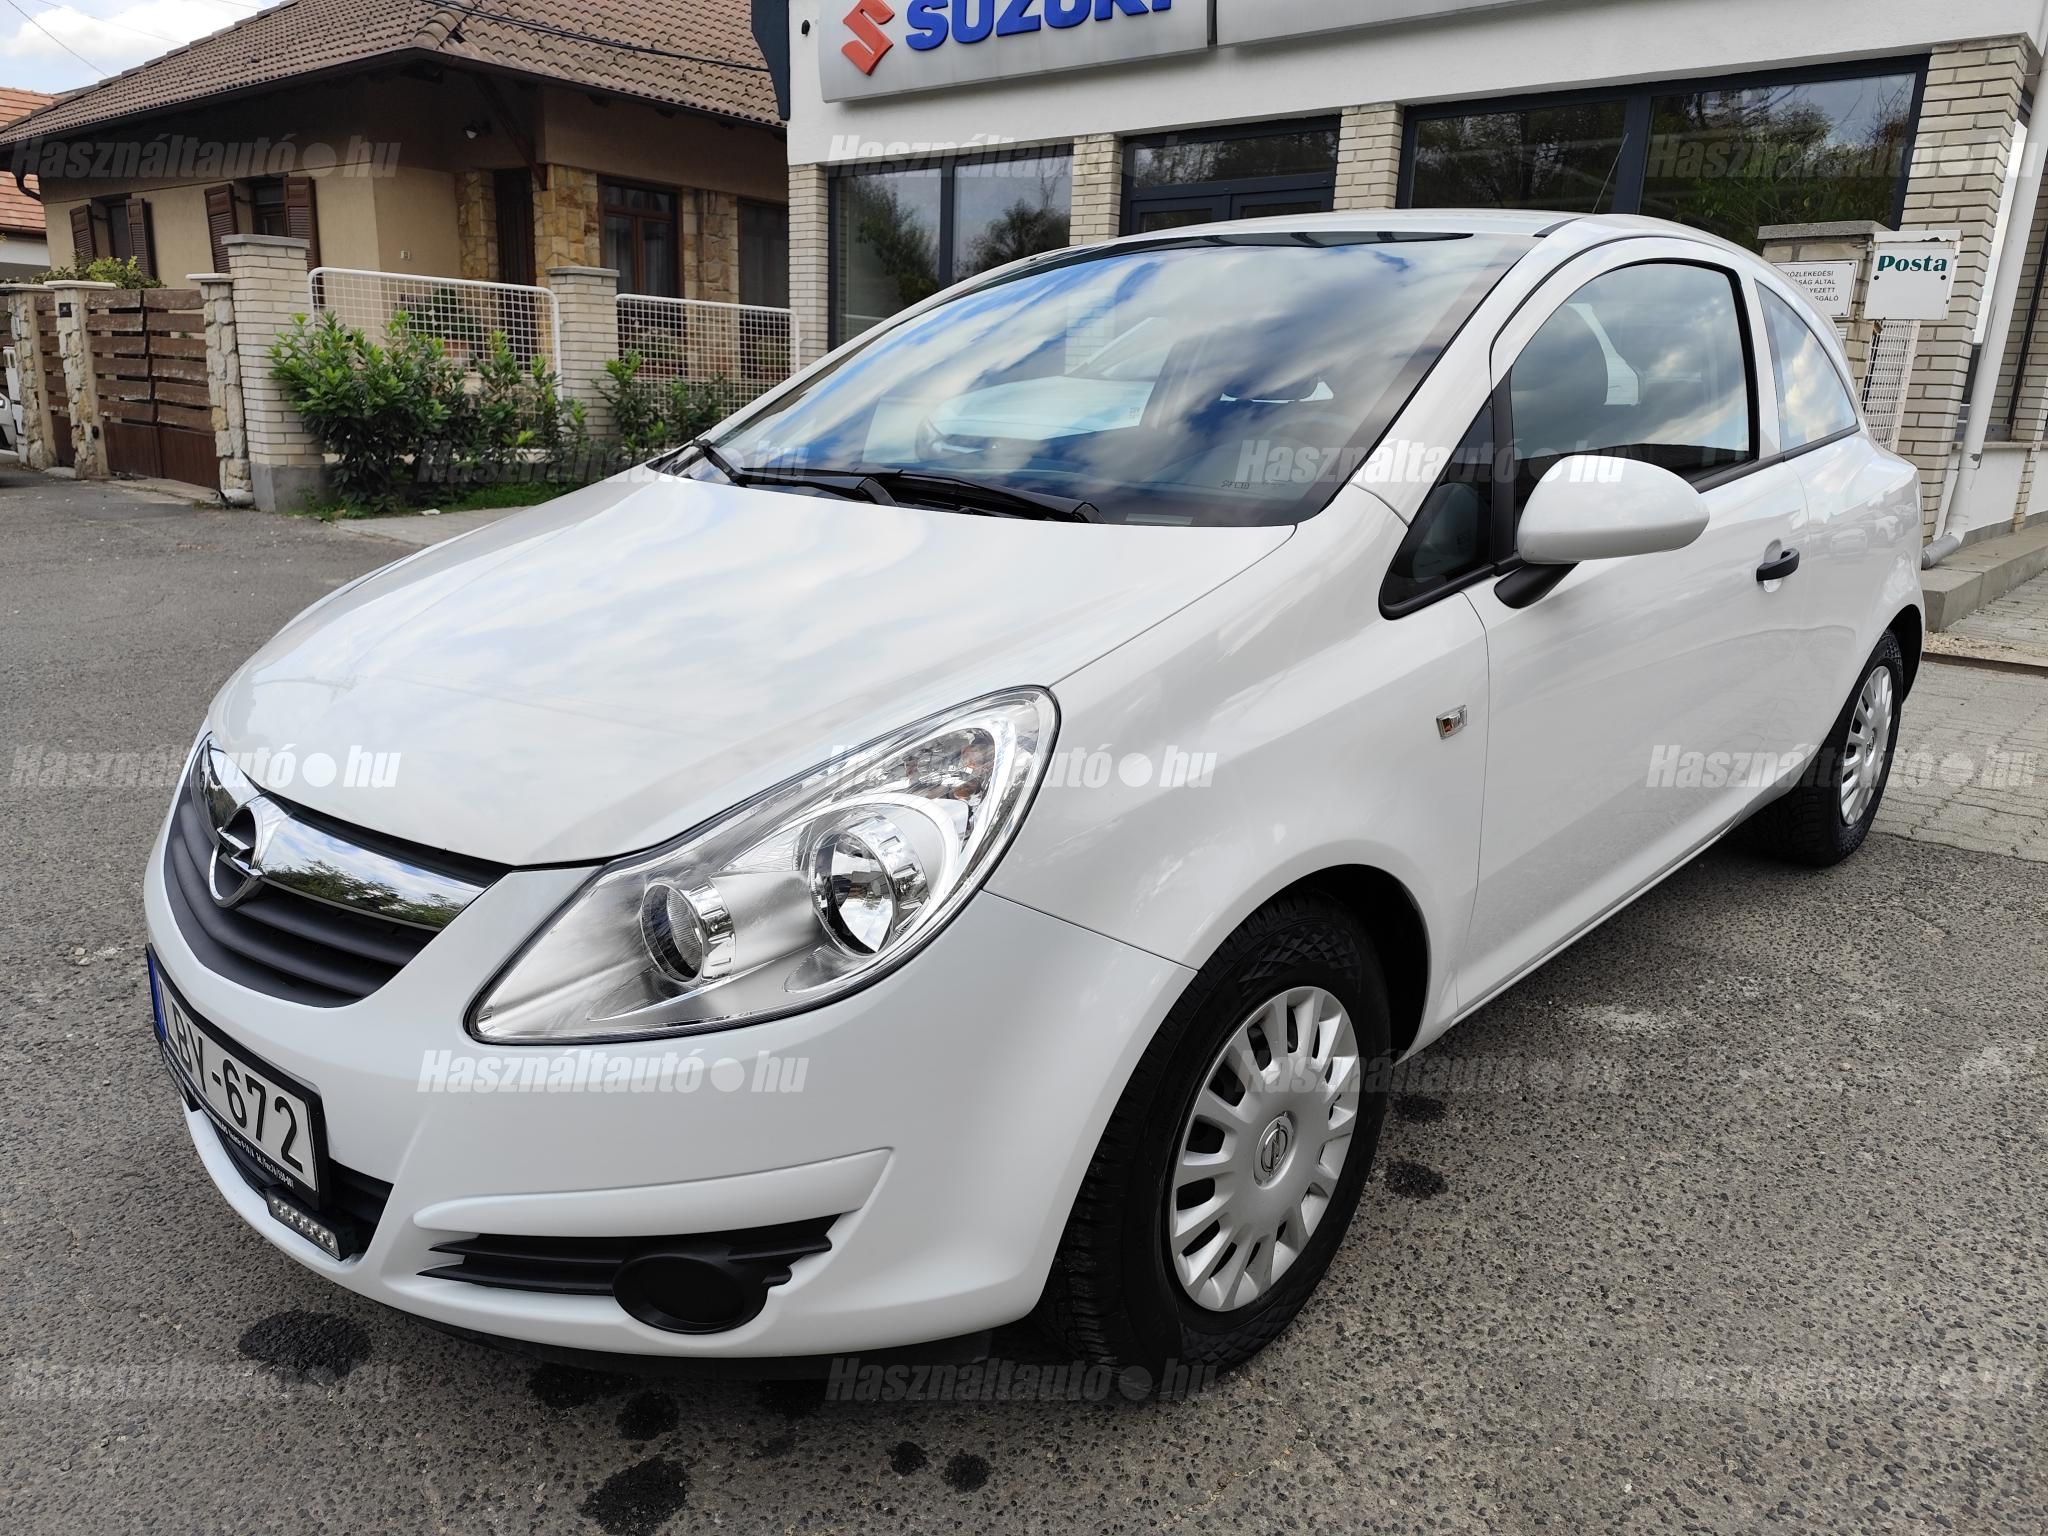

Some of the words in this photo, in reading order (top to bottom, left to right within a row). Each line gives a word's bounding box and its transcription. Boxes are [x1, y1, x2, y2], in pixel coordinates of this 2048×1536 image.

[905, 0, 1172, 51] SUZU
[1877, 255, 1947, 271] Posta
[158, 978, 304, 1173] LBY-672
